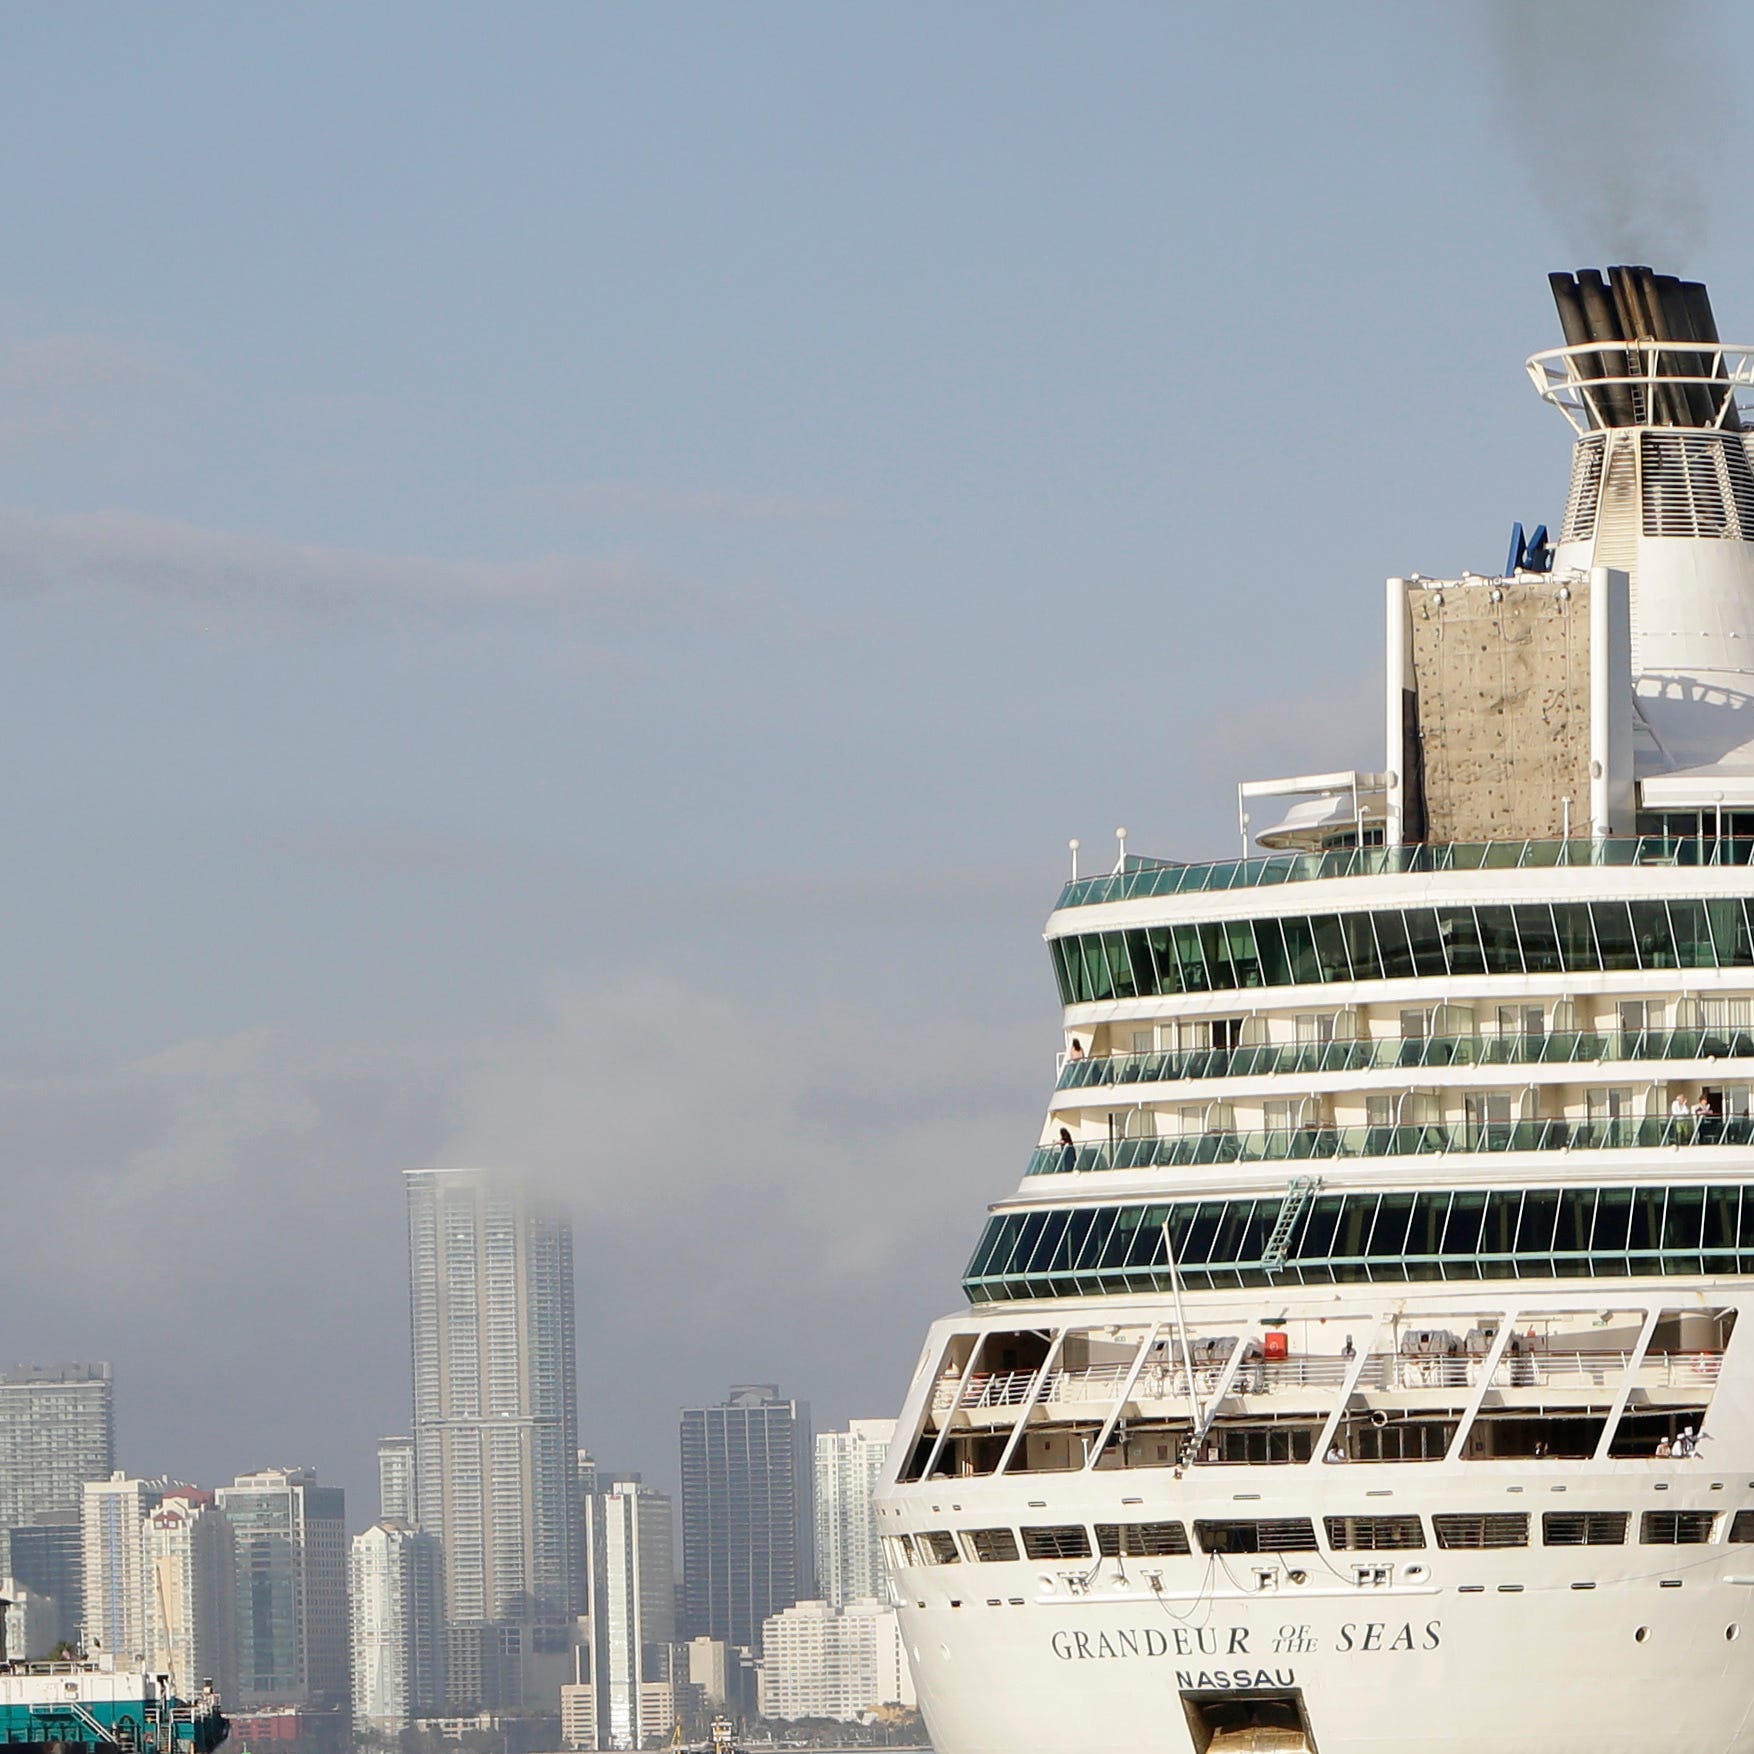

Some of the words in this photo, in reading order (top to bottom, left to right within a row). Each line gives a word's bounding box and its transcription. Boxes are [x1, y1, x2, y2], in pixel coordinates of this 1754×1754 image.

[1279, 1624, 1311, 1639] OF
[1335, 1620, 1441, 1652] SEAS
[1051, 1627, 1250, 1660] GRANDEUR
[1272, 1638, 1319, 1653] THE
[1175, 1668, 1295, 1688] NASSAU
